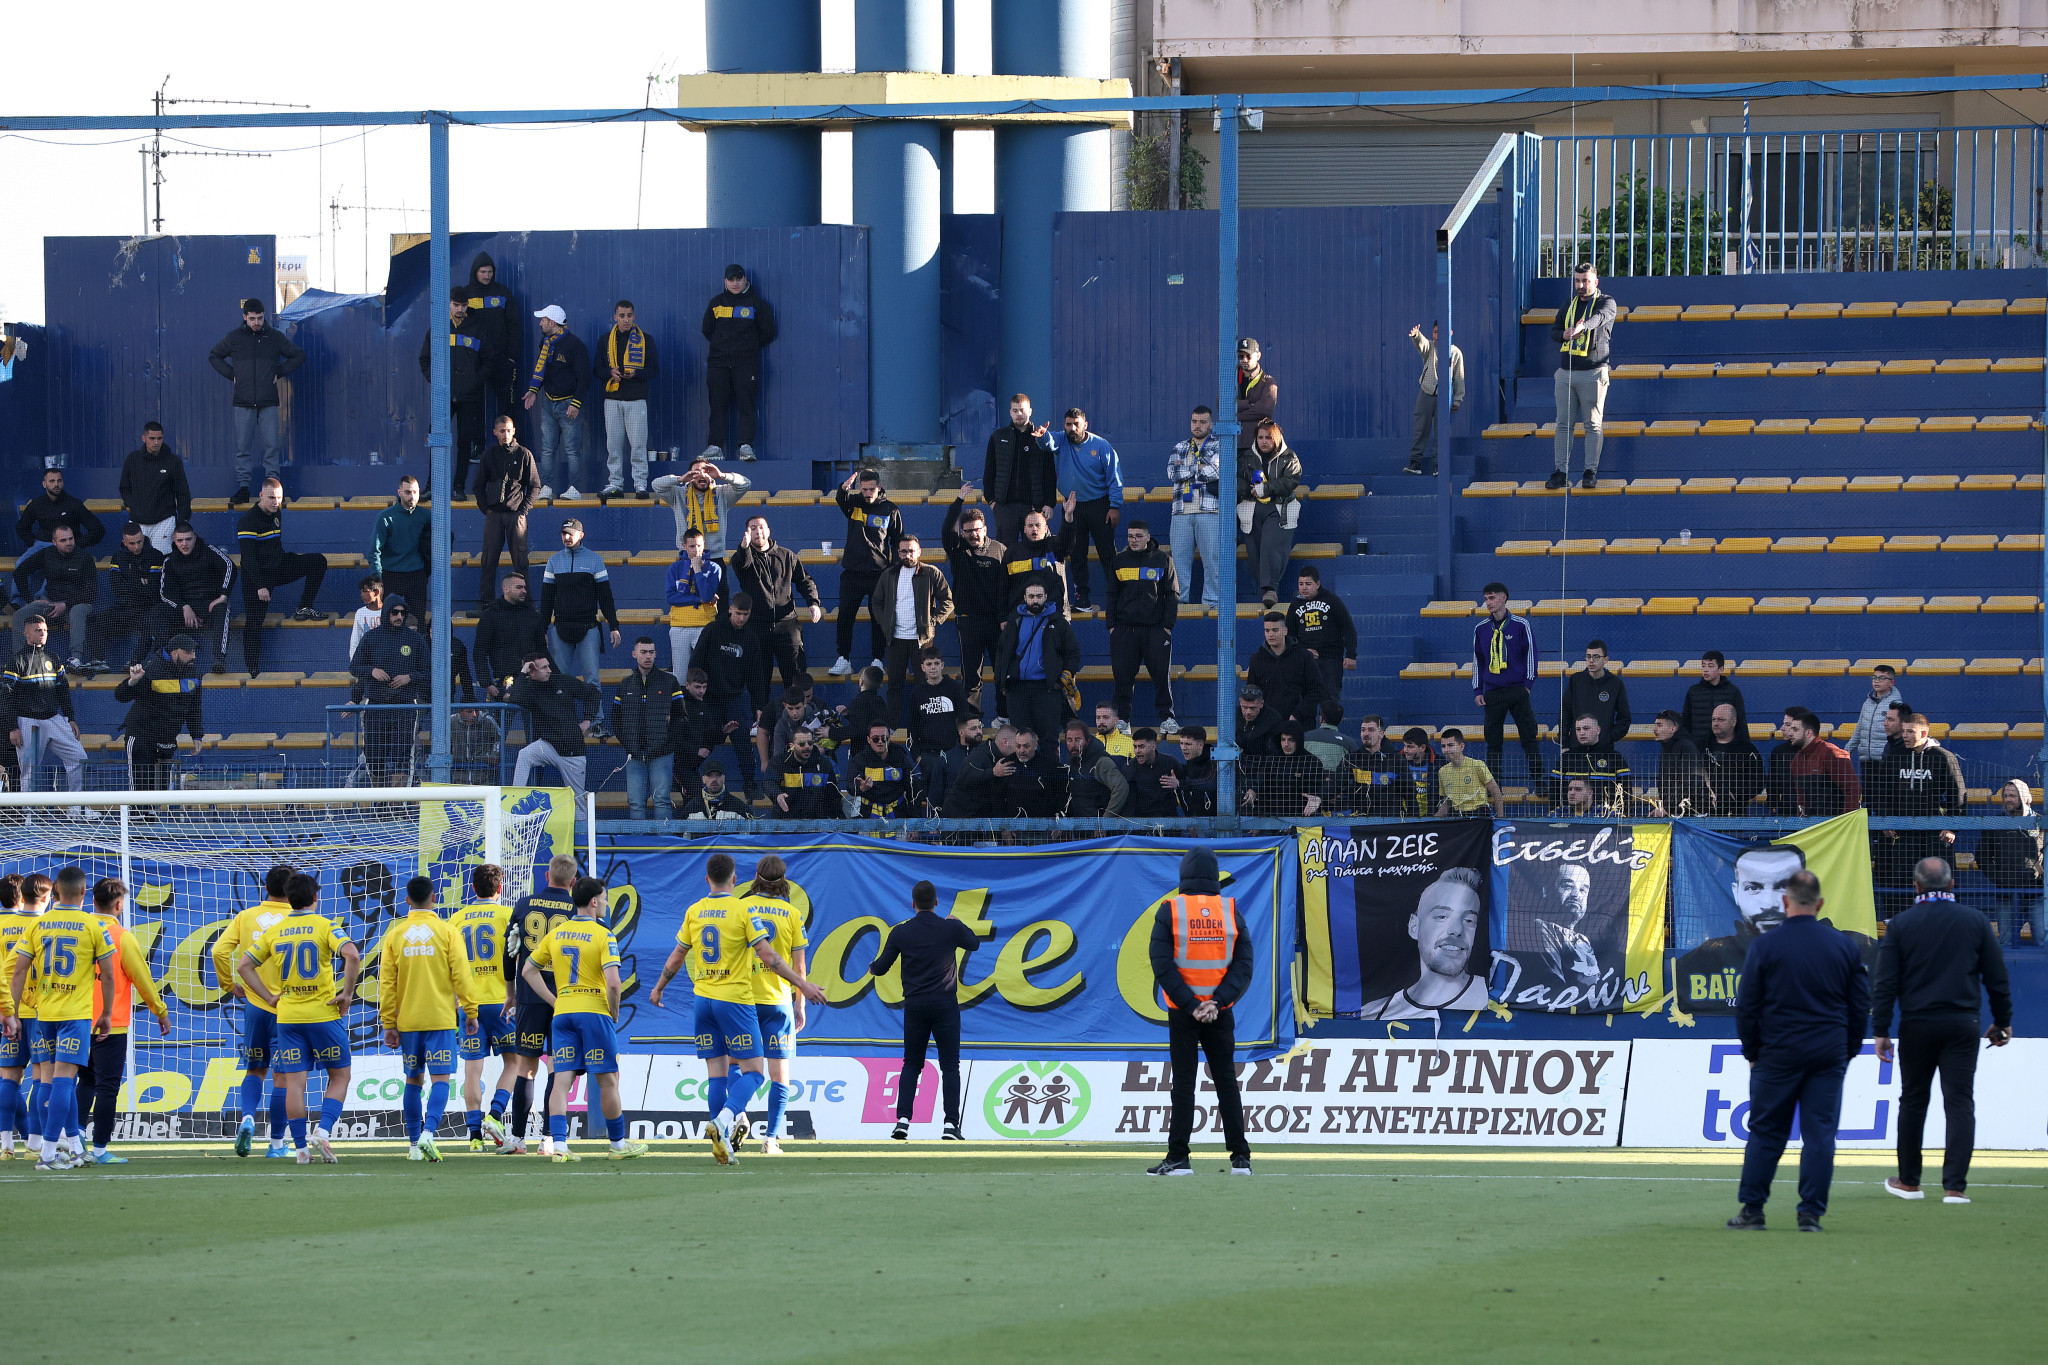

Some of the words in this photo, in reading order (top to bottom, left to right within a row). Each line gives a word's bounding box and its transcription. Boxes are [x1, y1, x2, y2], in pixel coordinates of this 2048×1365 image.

[1295, 605, 1306, 617] DC
[1306, 601, 1330, 613] SHOES
[1900, 769, 1932, 780] NASA
[529, 899, 573, 911] KUCHERENKO
[698, 910, 727, 919] AGIRRE
[38, 921, 85, 931] MANRIQUE
[1190, 919, 1223, 929] GOLDEN
[280, 926, 314, 937] LOBATO
[461, 923, 496, 962] 16
[701, 924, 721, 964] 9
[41, 935, 78, 978] 15
[403, 945, 435, 957] errea
[275, 940, 319, 981] 70
[561, 945, 580, 986] 7
[521, 1032, 544, 1045] A4B
[426, 1050, 452, 1062] A4B
[1120, 1050, 1327, 1092] ΕΩΣΗ
[1339, 1049, 1614, 1094] ΑΓΡΙΝΙΟΥ
[629, 1115, 795, 1140] novet
[1320, 1107, 1606, 1135] ΣΥΝΕΤΑΙΡΙΣΜΟΣ
